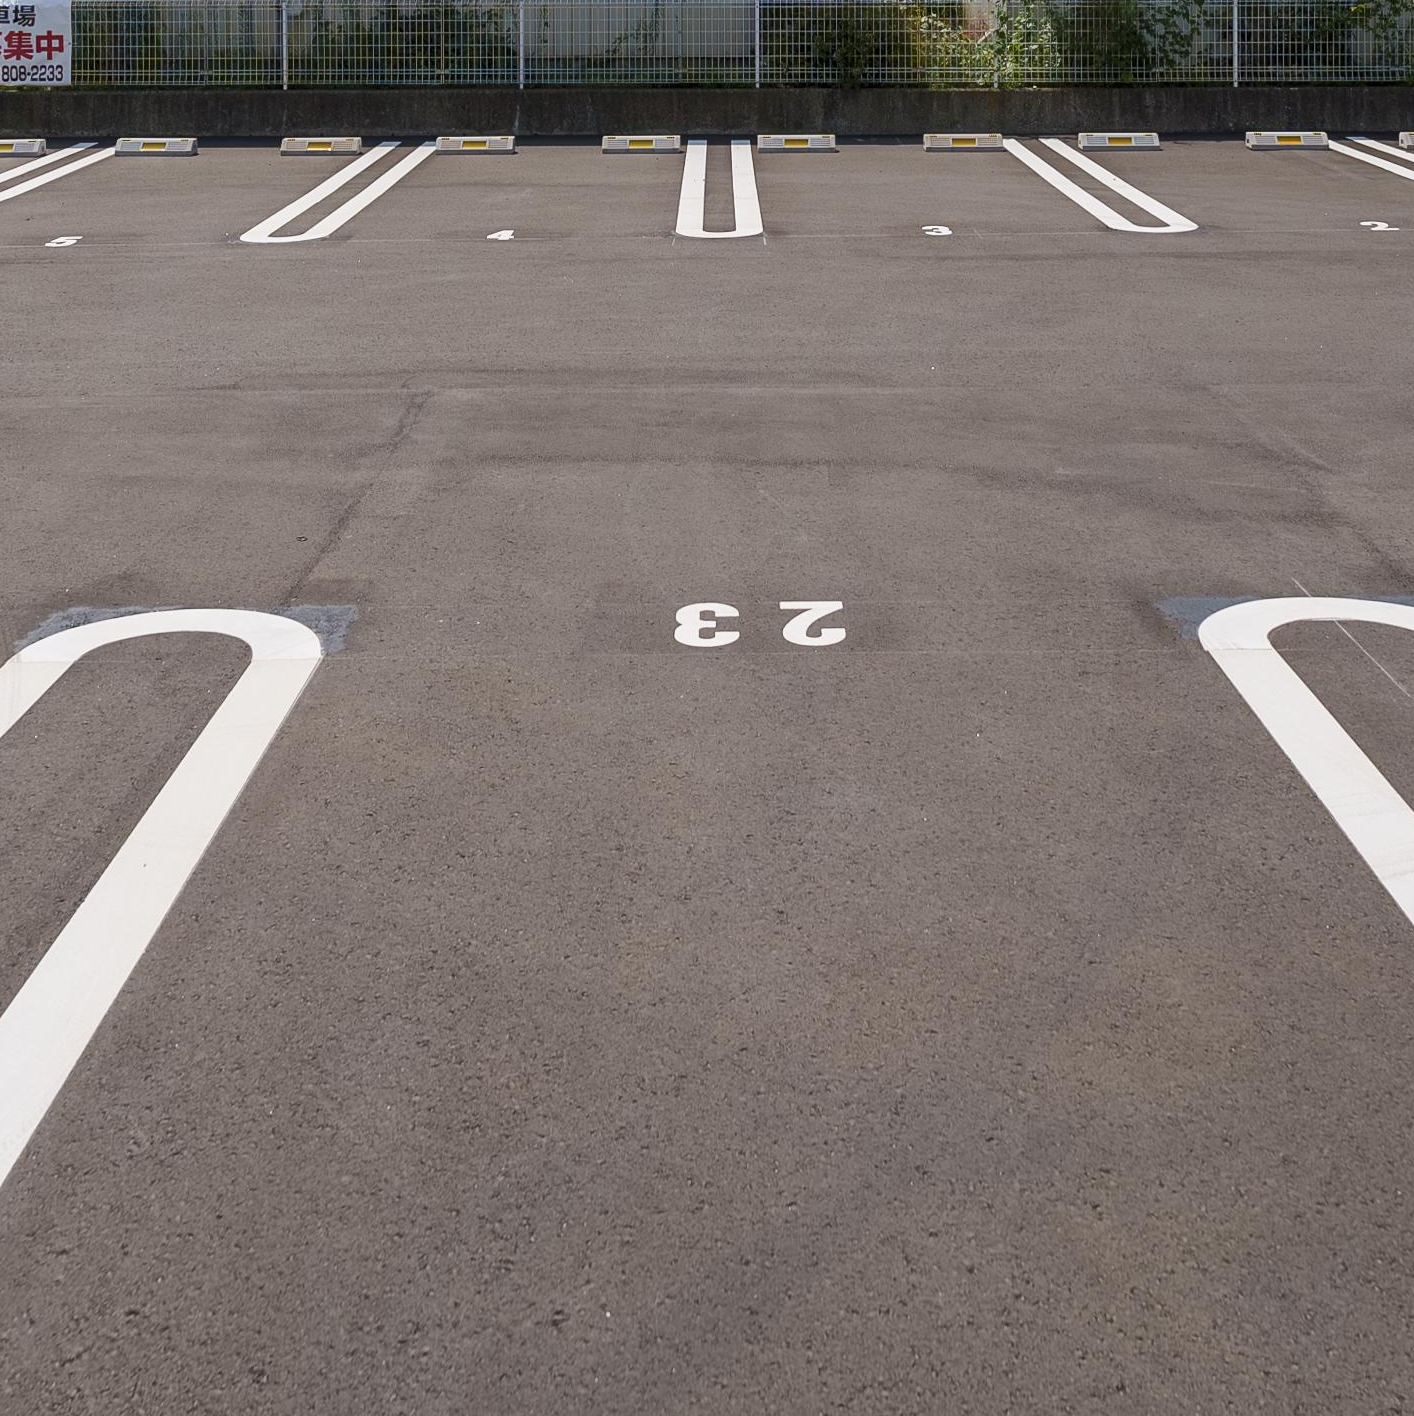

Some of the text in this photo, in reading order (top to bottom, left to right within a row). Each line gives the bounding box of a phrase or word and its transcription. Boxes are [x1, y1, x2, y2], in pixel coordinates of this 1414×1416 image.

[486, 229, 516, 241] 4
[921, 224, 953, 236] 3
[44, 235, 84, 248] 5
[673, 600, 847, 648] 23
